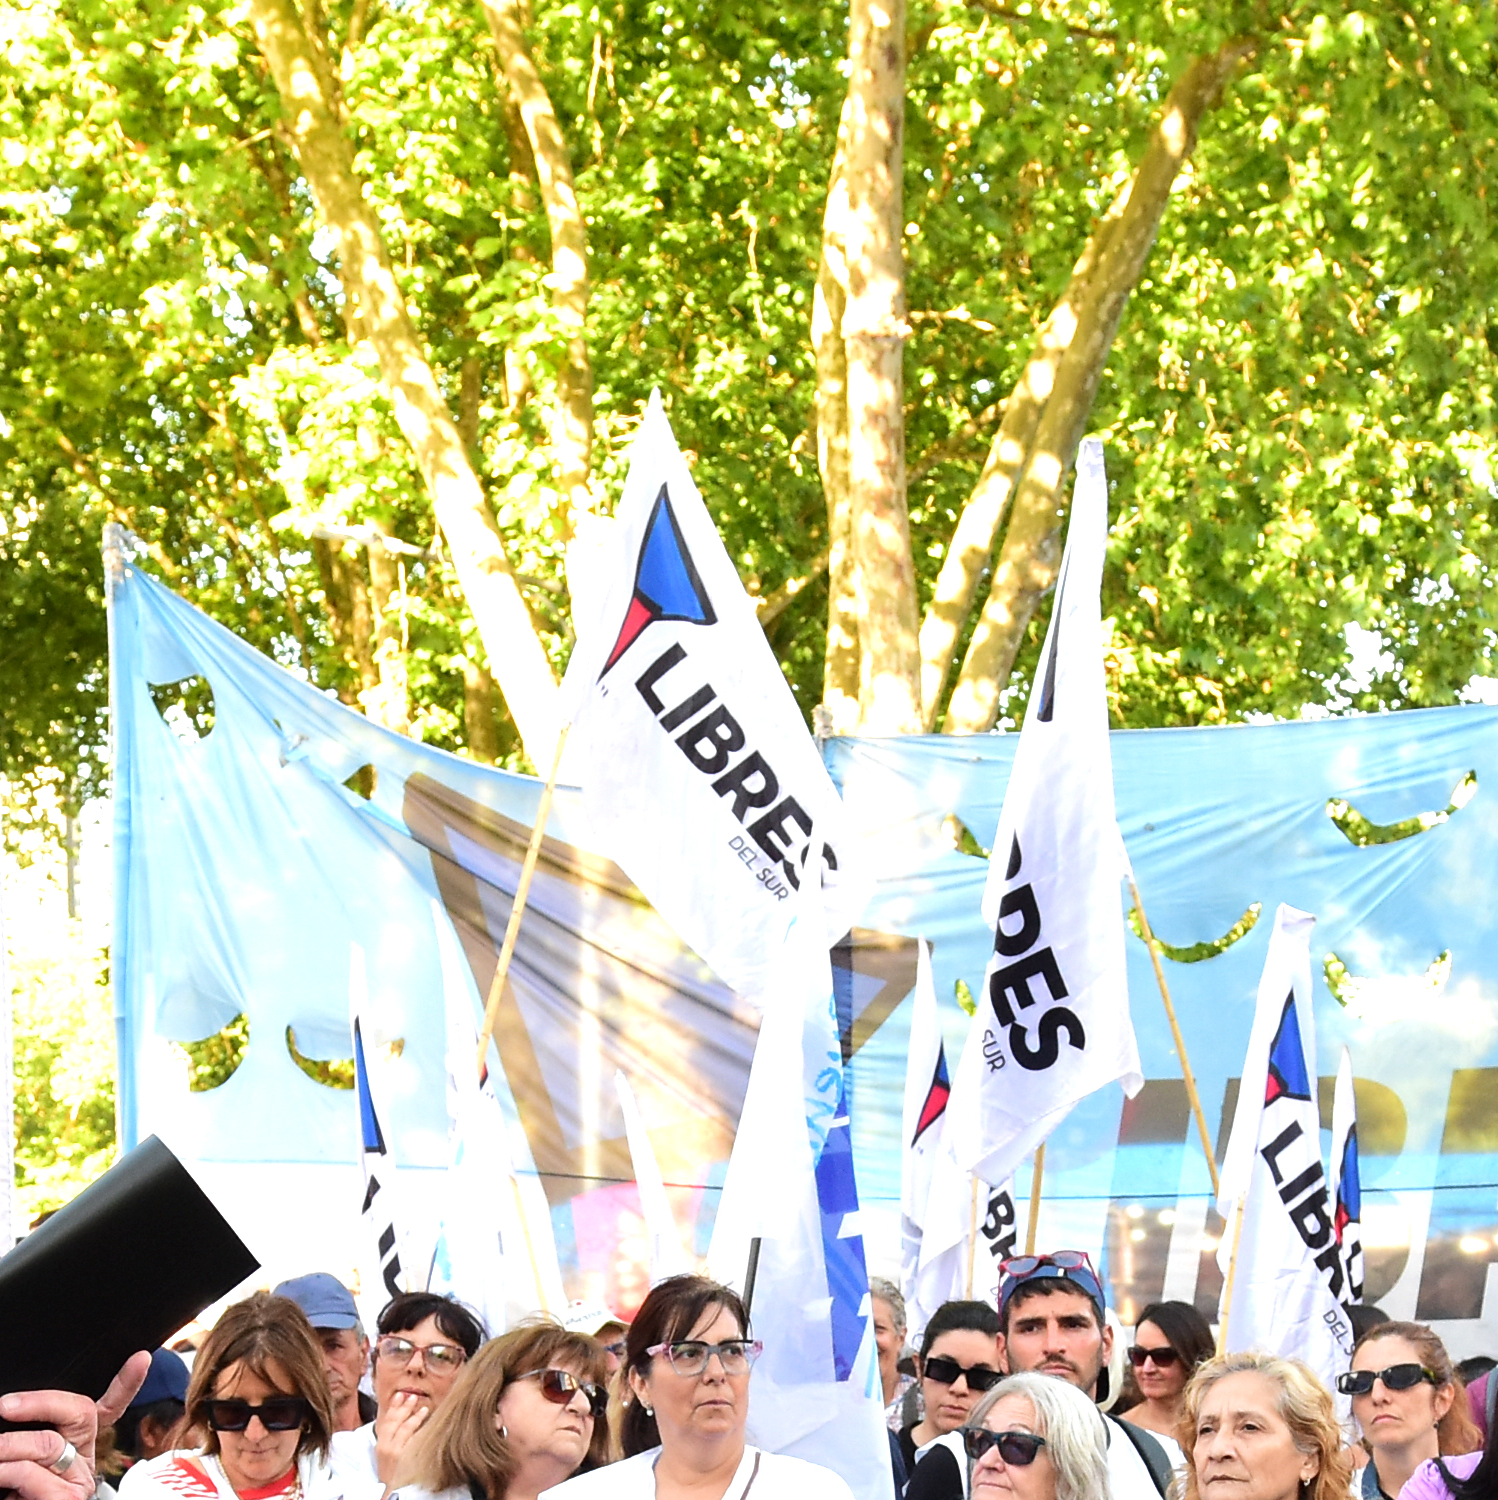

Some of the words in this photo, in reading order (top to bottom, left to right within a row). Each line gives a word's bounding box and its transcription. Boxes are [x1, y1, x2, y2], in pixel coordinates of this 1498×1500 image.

[634, 641, 838, 893] LIBRES
[728, 835, 758, 871] DEL
[755, 867, 790, 902] SUR
[981, 1028, 1006, 1073] SUR
[1322, 1309, 1350, 1344] DEL
